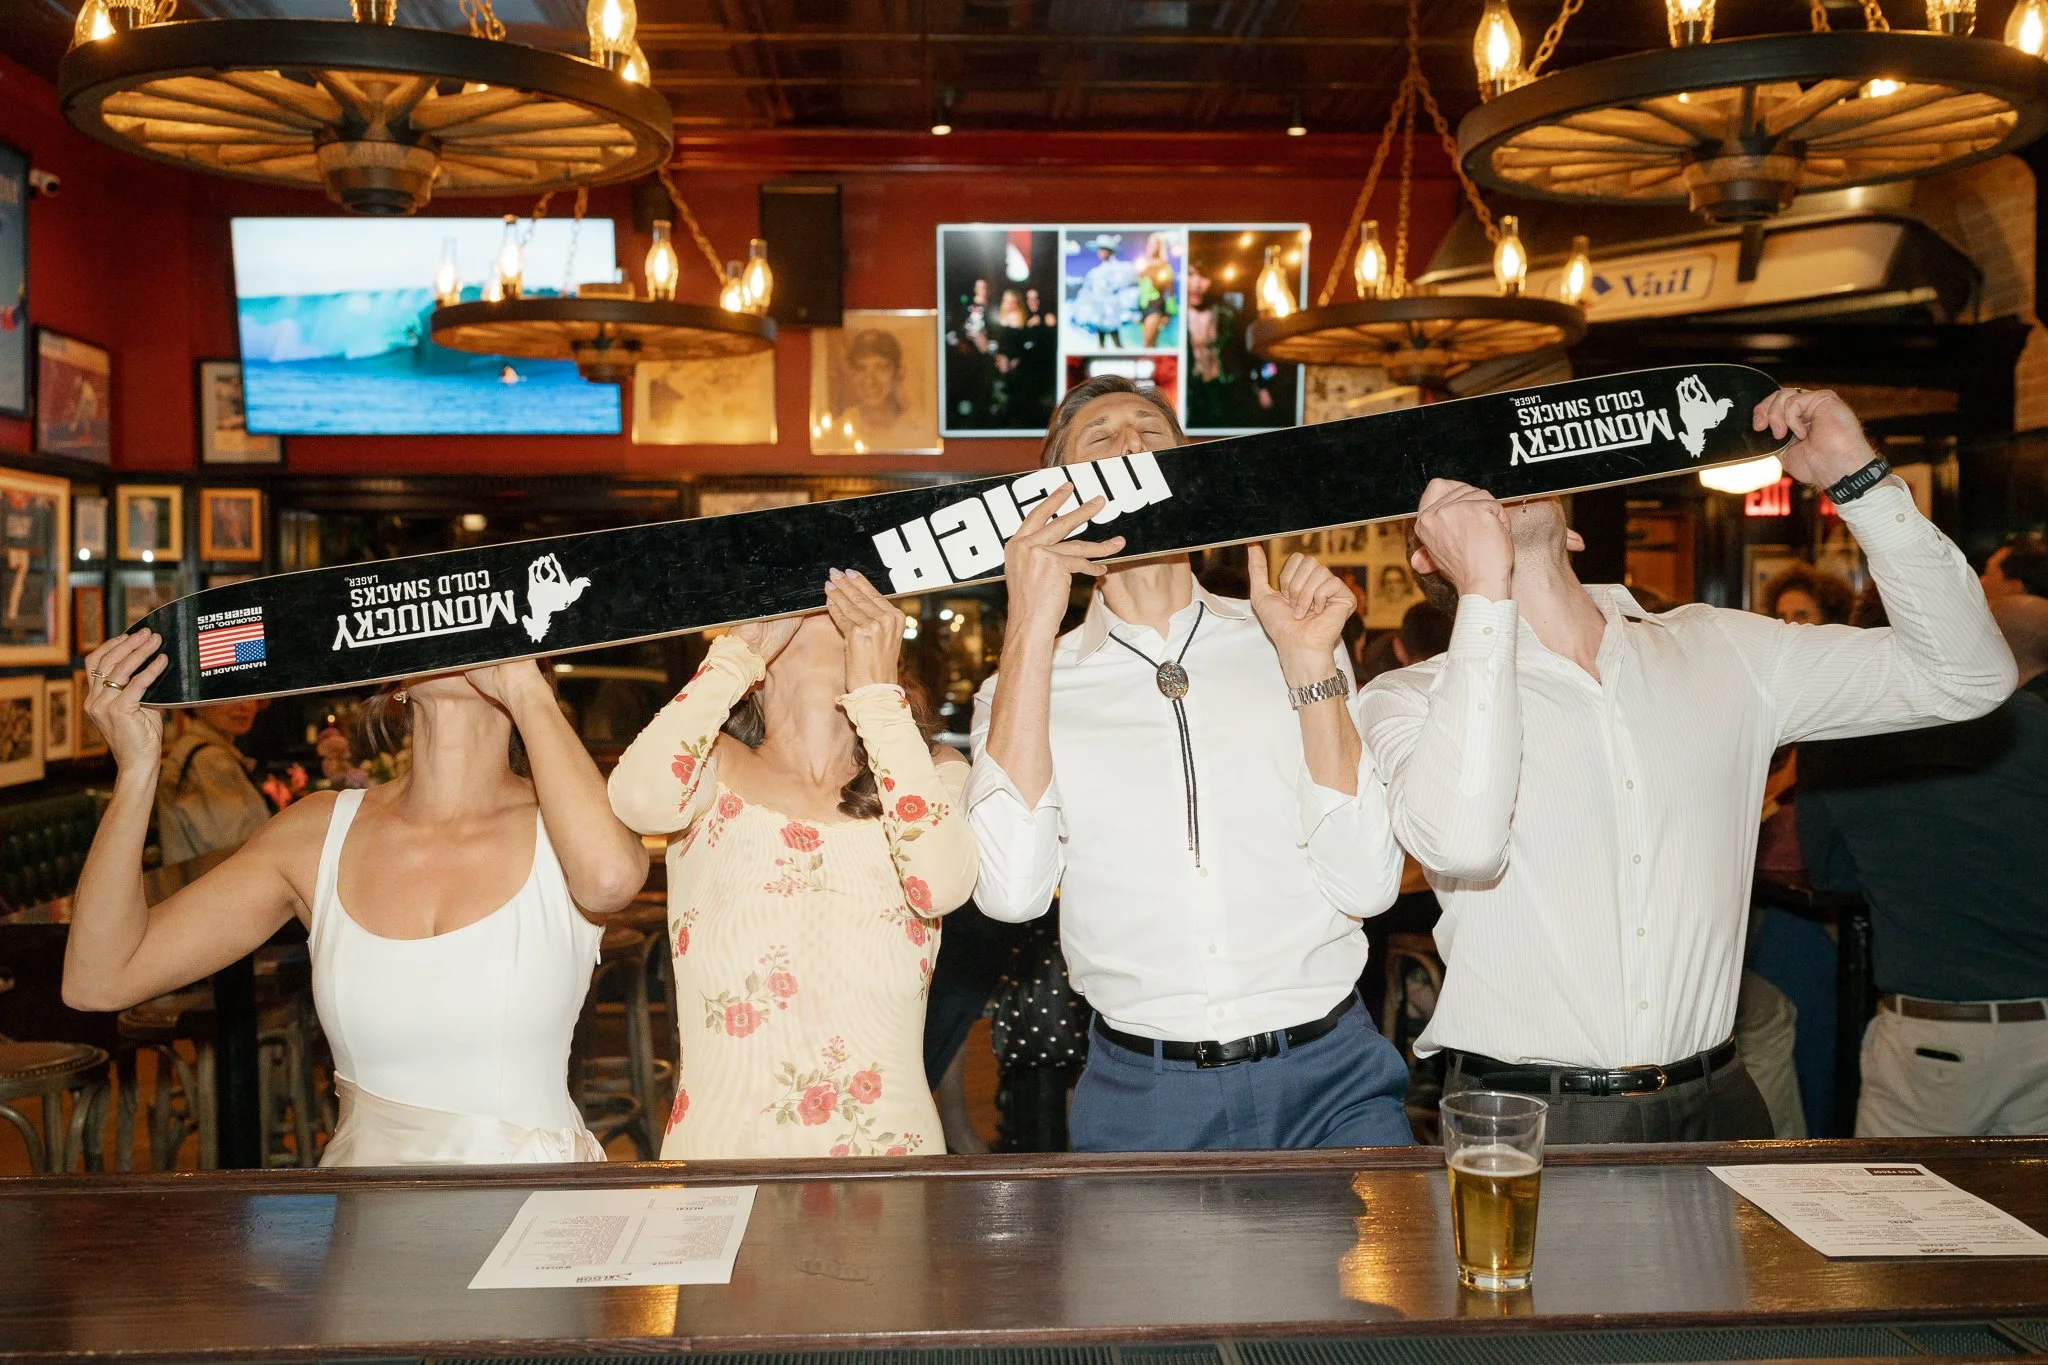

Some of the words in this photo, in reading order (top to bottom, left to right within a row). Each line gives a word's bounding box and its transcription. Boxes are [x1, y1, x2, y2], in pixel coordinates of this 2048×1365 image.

[1621, 267, 1693, 298] Vail
[1514, 394, 1541, 407] LAGER
[1516, 398, 1591, 426] SNACKS
[1595, 388, 1645, 415] COLD
[1509, 407, 1676, 467] MONTUCKY
[348, 574, 379, 588] LAGER
[349, 577, 431, 609] SNACKS
[437, 569, 490, 595] COLD
[198, 622, 215, 631] USA
[215, 615, 263, 628] COLORADO,
[331, 589, 517, 651] MONTUCKY
[201, 670, 212, 678] IN
[212, 660, 267, 676] HANDMADE
